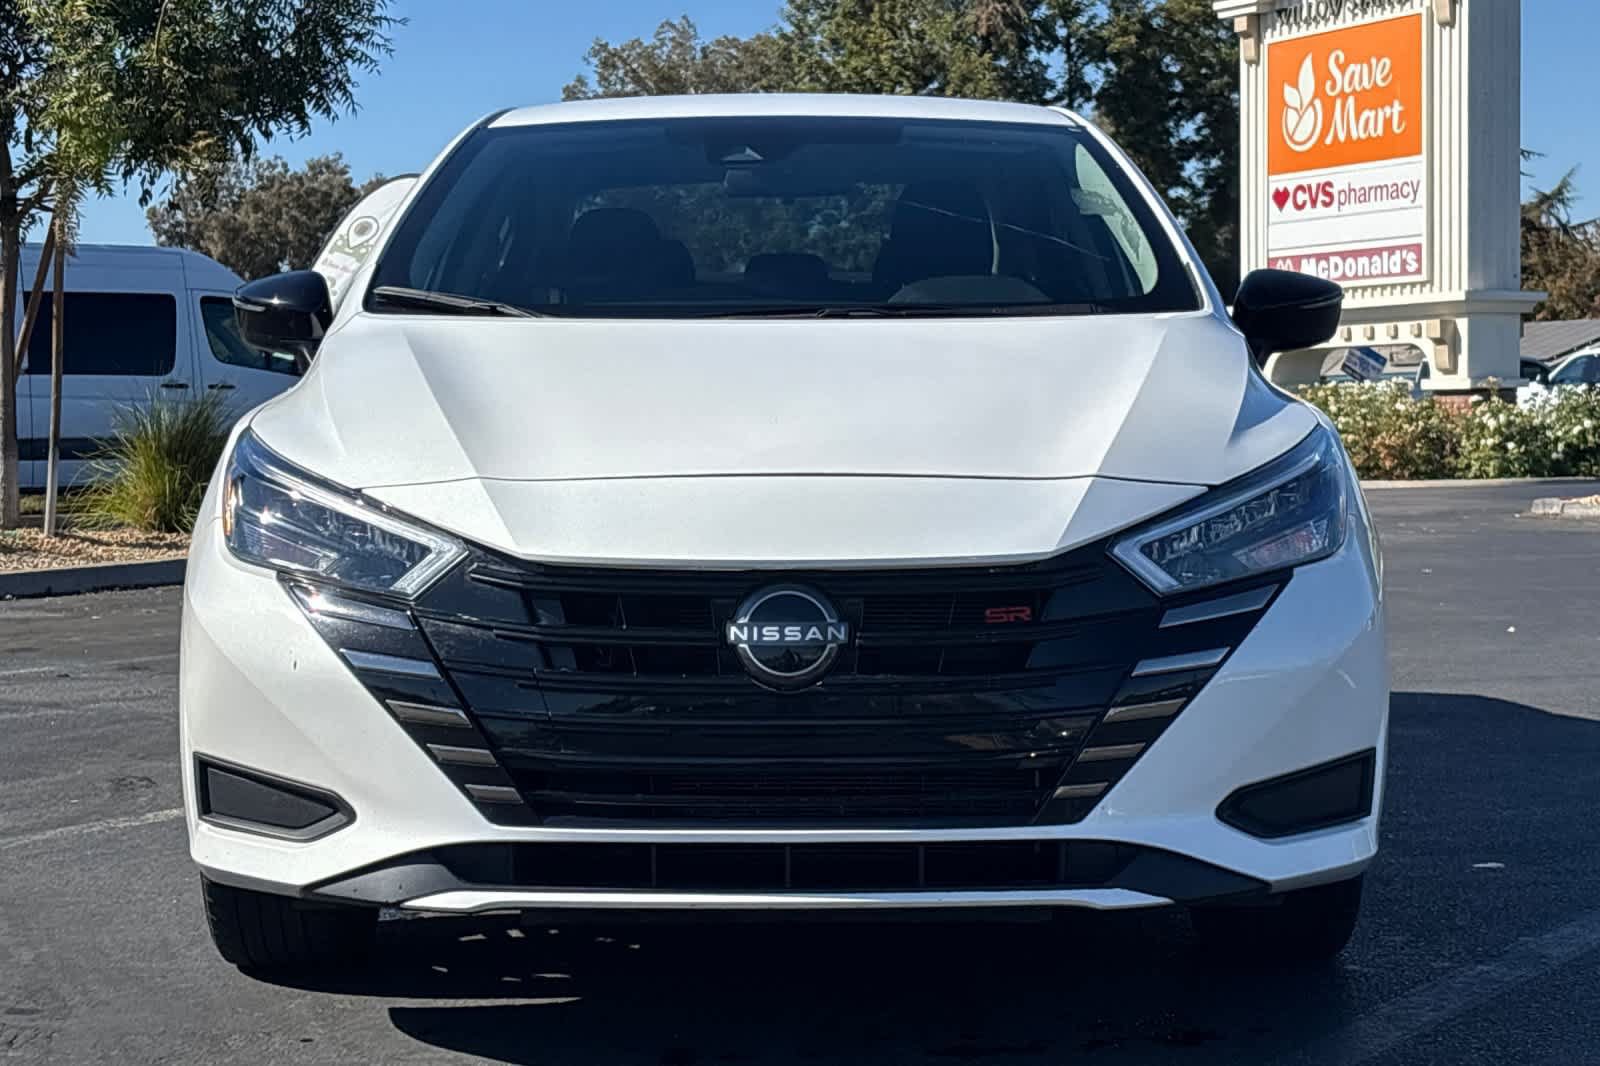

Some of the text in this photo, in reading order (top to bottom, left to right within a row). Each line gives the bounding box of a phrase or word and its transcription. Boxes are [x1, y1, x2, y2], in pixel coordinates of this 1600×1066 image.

[1325, 49, 1393, 97] Save
[1324, 95, 1406, 145] Mart
[1292, 179, 1421, 212] CVS pharmacy
[1300, 250, 1419, 279] McDonald's
[984, 606, 1031, 622] SR
[729, 625, 846, 641] NISSAN
